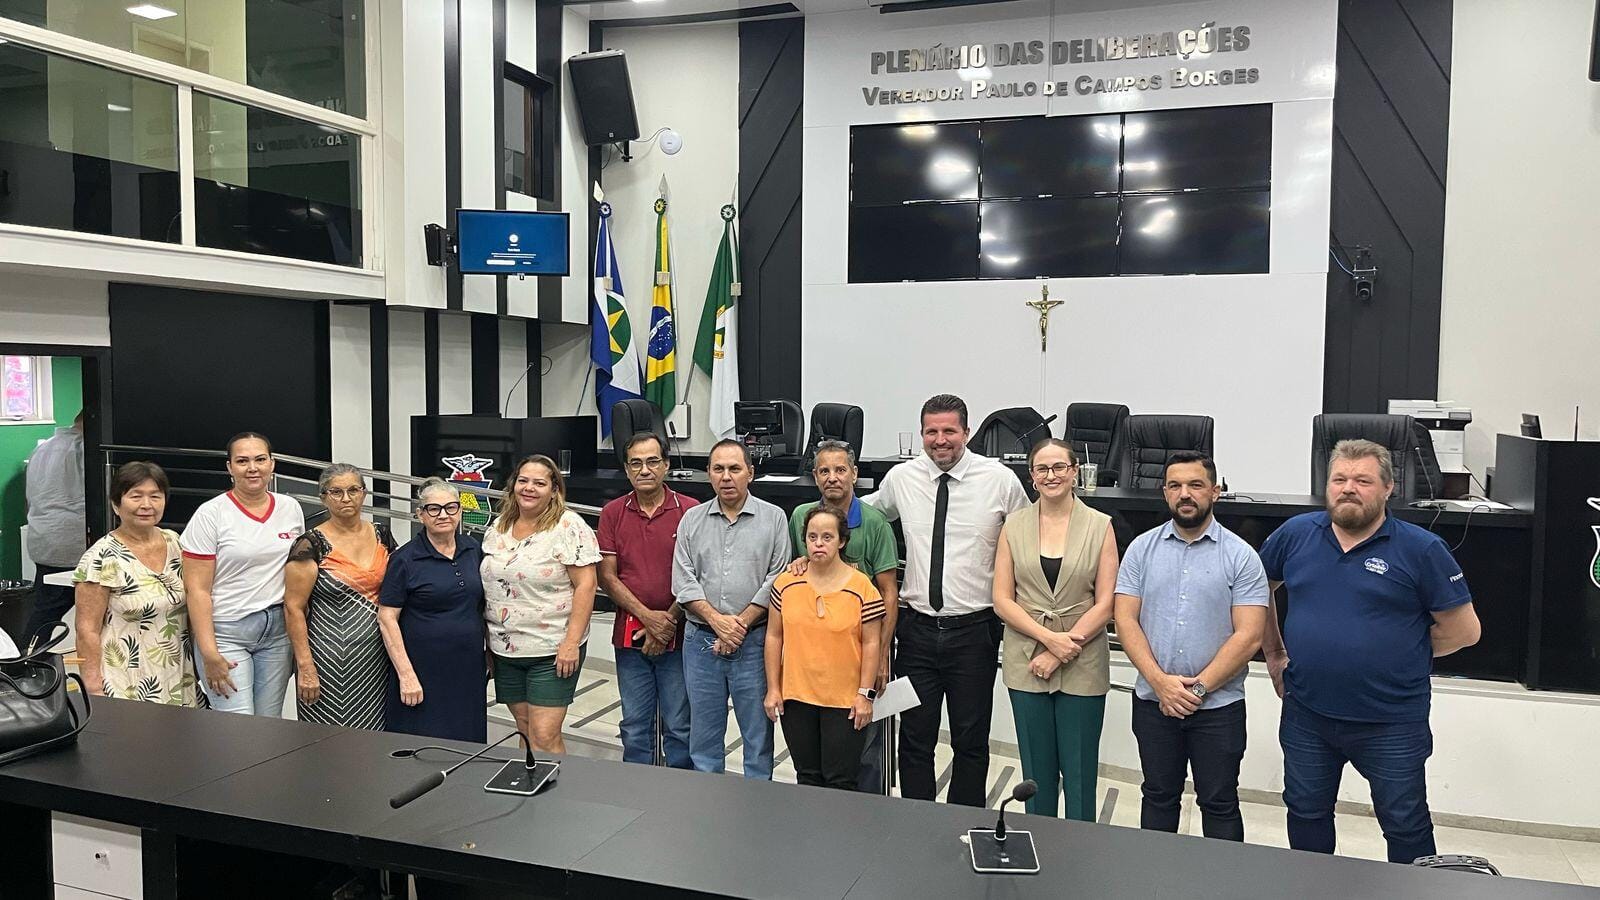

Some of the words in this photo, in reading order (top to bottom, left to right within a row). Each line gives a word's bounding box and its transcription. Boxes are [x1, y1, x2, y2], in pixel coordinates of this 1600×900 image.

[870, 43, 986, 75] PLENÁRIO
[993, 40, 1044, 68] DAS
[1052, 21, 1250, 65] DELIBERAÇÕES
[862, 86, 965, 106] VEREADOR
[970, 79, 1037, 99] PAULO
[1043, 81, 1068, 97] DE
[1074, 75, 1163, 97] CAMPOS
[1170, 67, 1260, 89] BORGES
